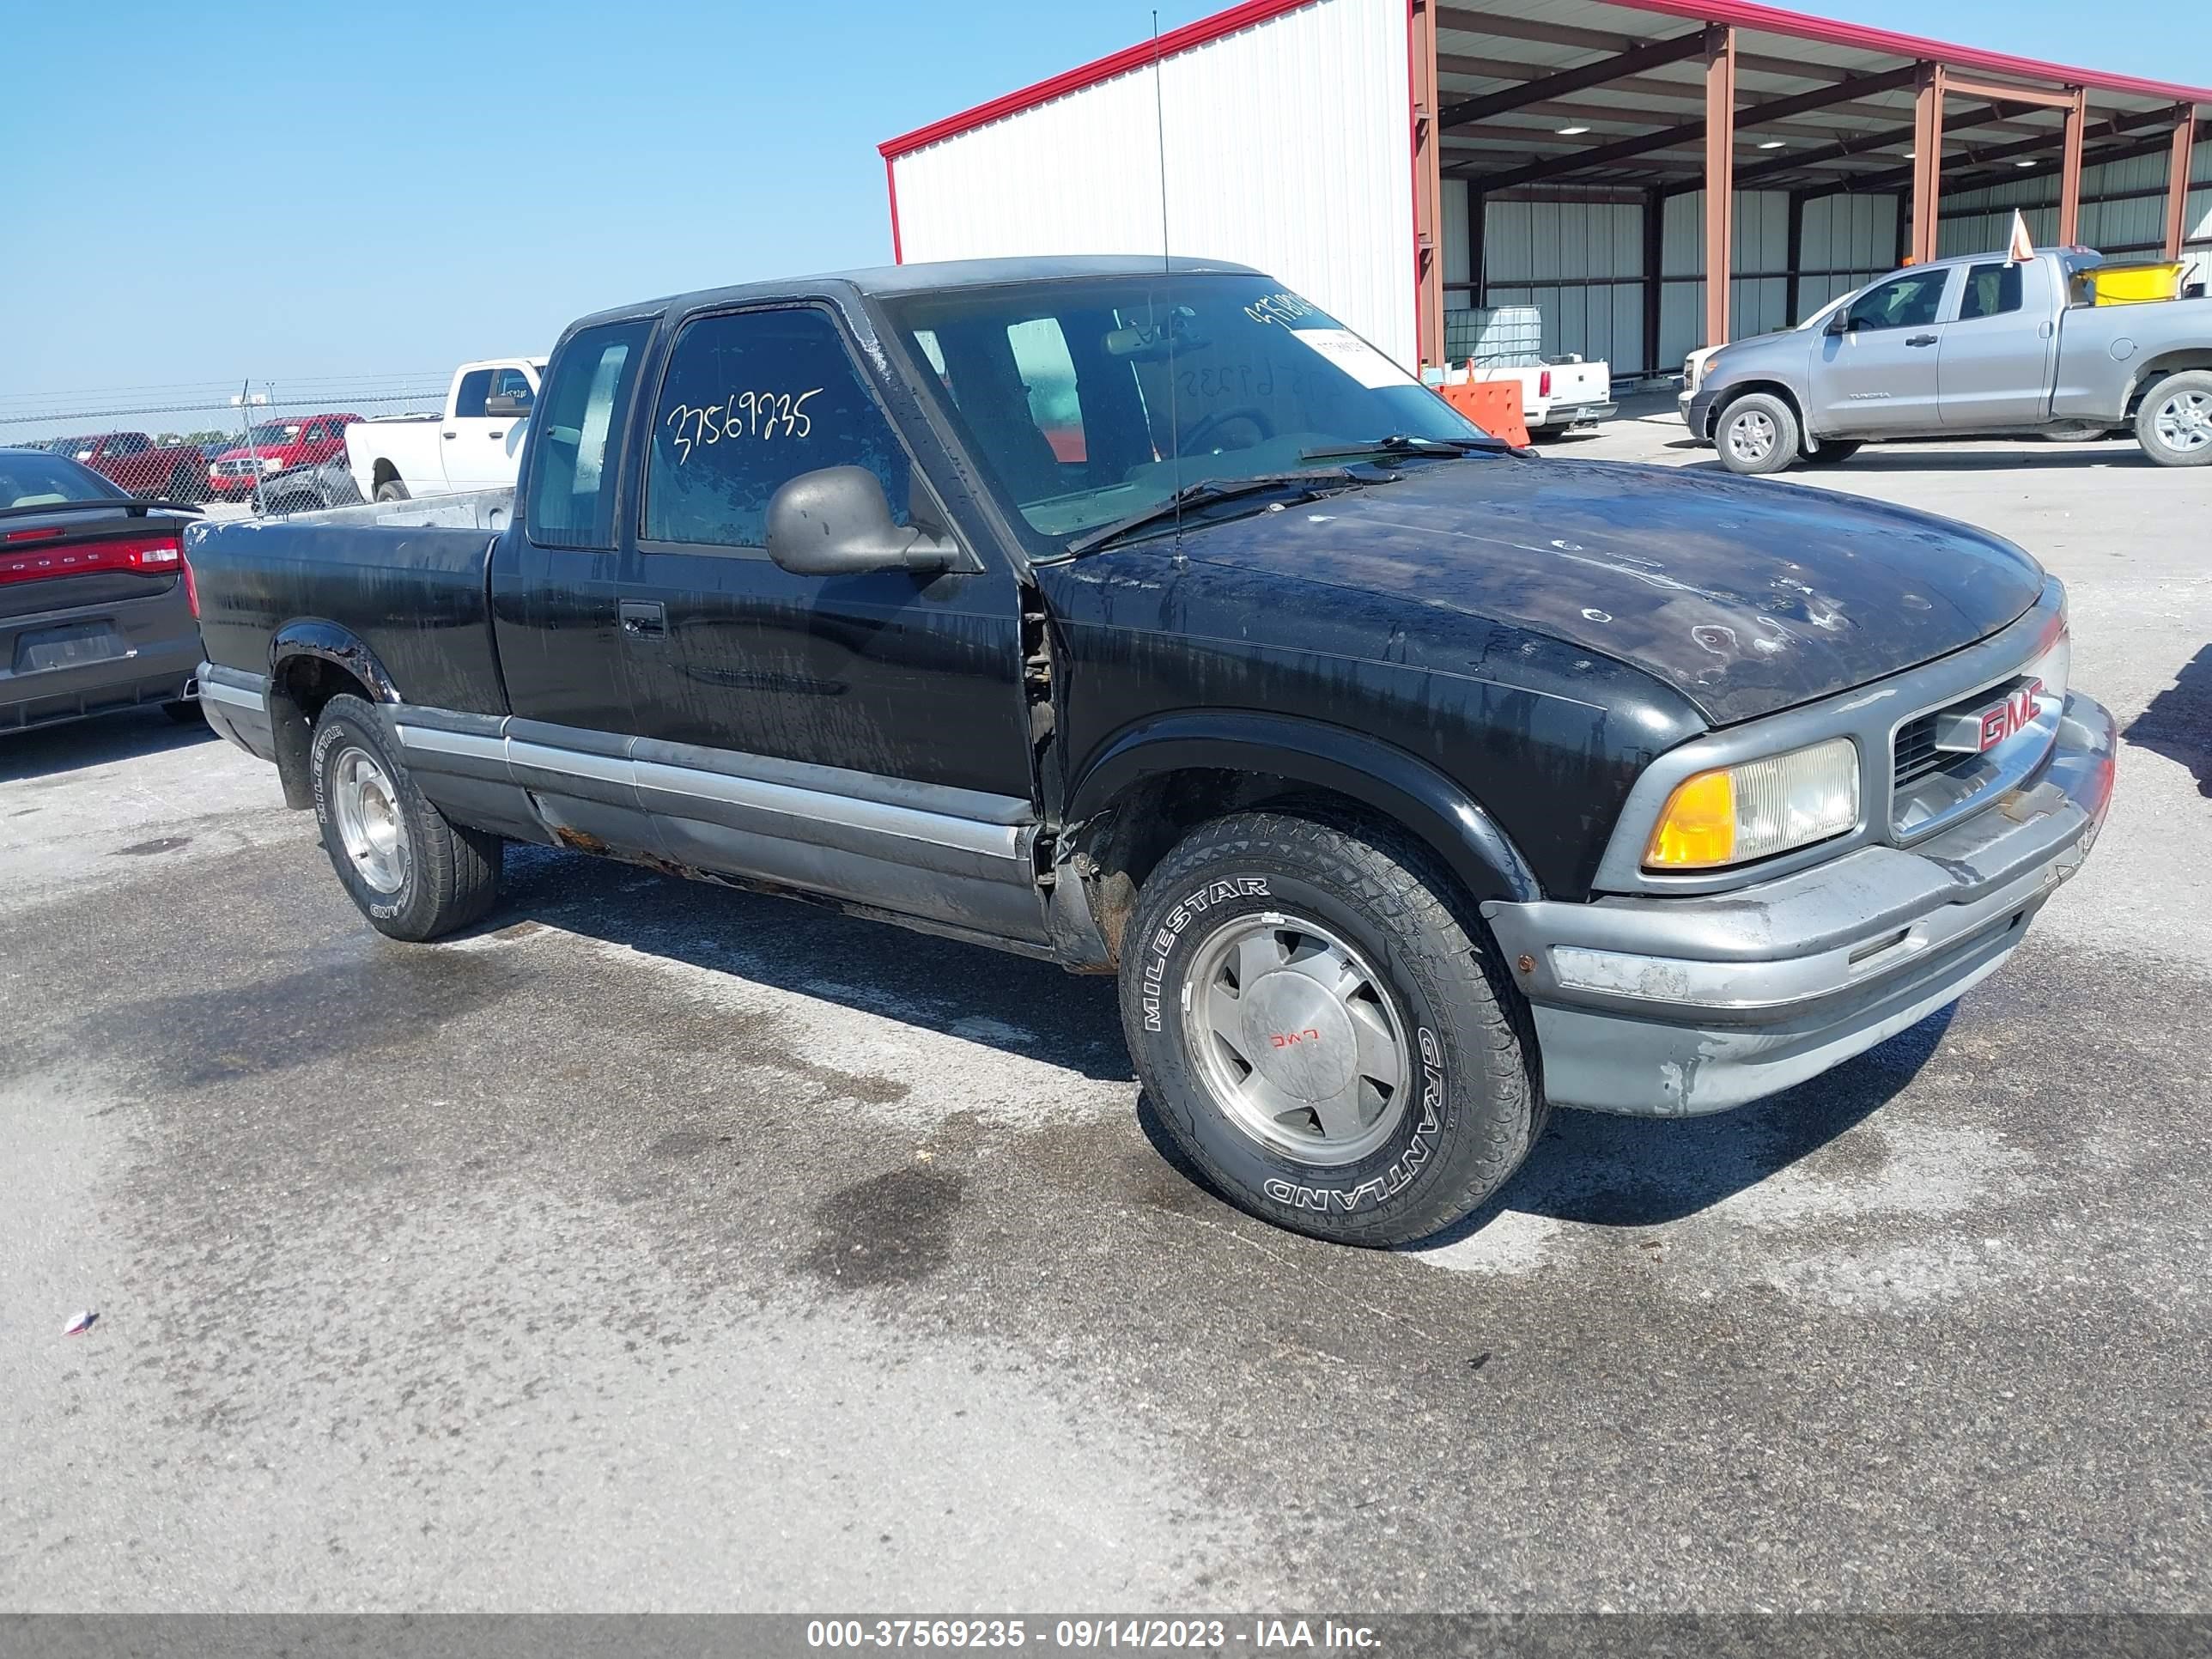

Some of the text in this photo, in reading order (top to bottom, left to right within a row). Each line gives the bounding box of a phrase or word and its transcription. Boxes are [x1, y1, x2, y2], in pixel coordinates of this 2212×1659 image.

[667, 387, 823, 466] 37569235
[1980, 678, 2044, 752] GMC
[313, 726, 344, 823] MILESTAR
[1143, 878, 1271, 1032] MILESTAR
[1263, 1027, 1443, 1211] GRANTLAND
